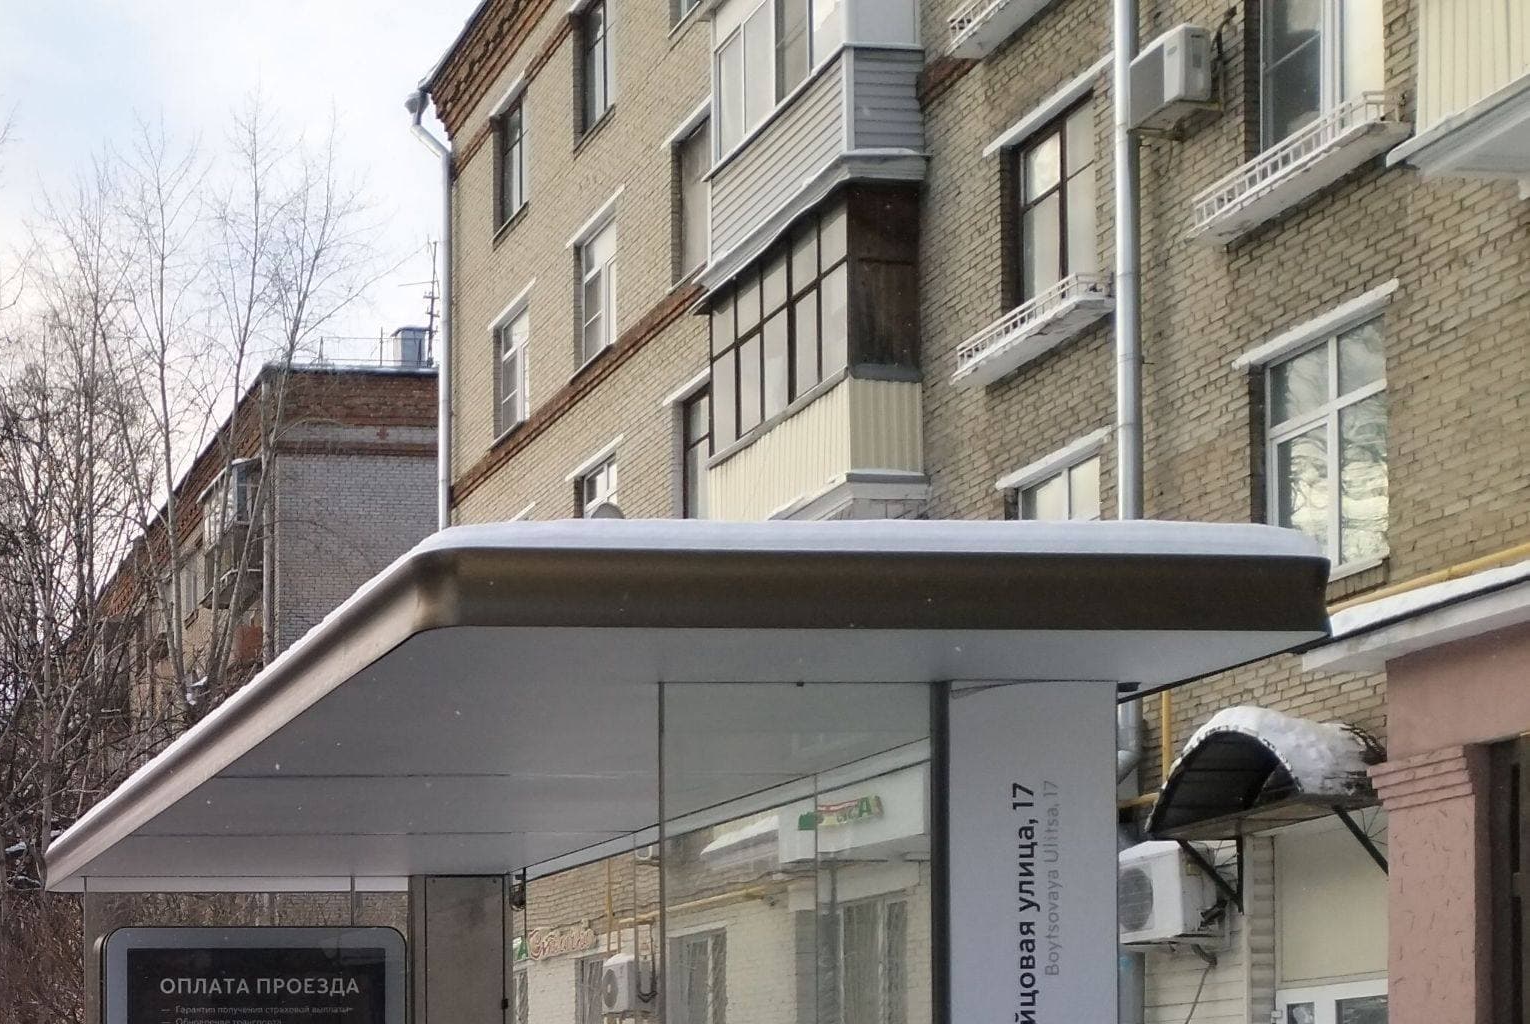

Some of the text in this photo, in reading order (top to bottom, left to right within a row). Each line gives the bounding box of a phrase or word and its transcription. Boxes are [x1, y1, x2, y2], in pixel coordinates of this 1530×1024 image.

[1012, 781, 1035, 811] 17
[1018, 818, 1041, 913] улица,
[1043, 779, 1063, 977] Boytsovaya Ulitsa, 17
[160, 978, 359, 997] ОПЛАТА ПРОЕЗДА
[175, 1005, 216, 1015] Гарантия
